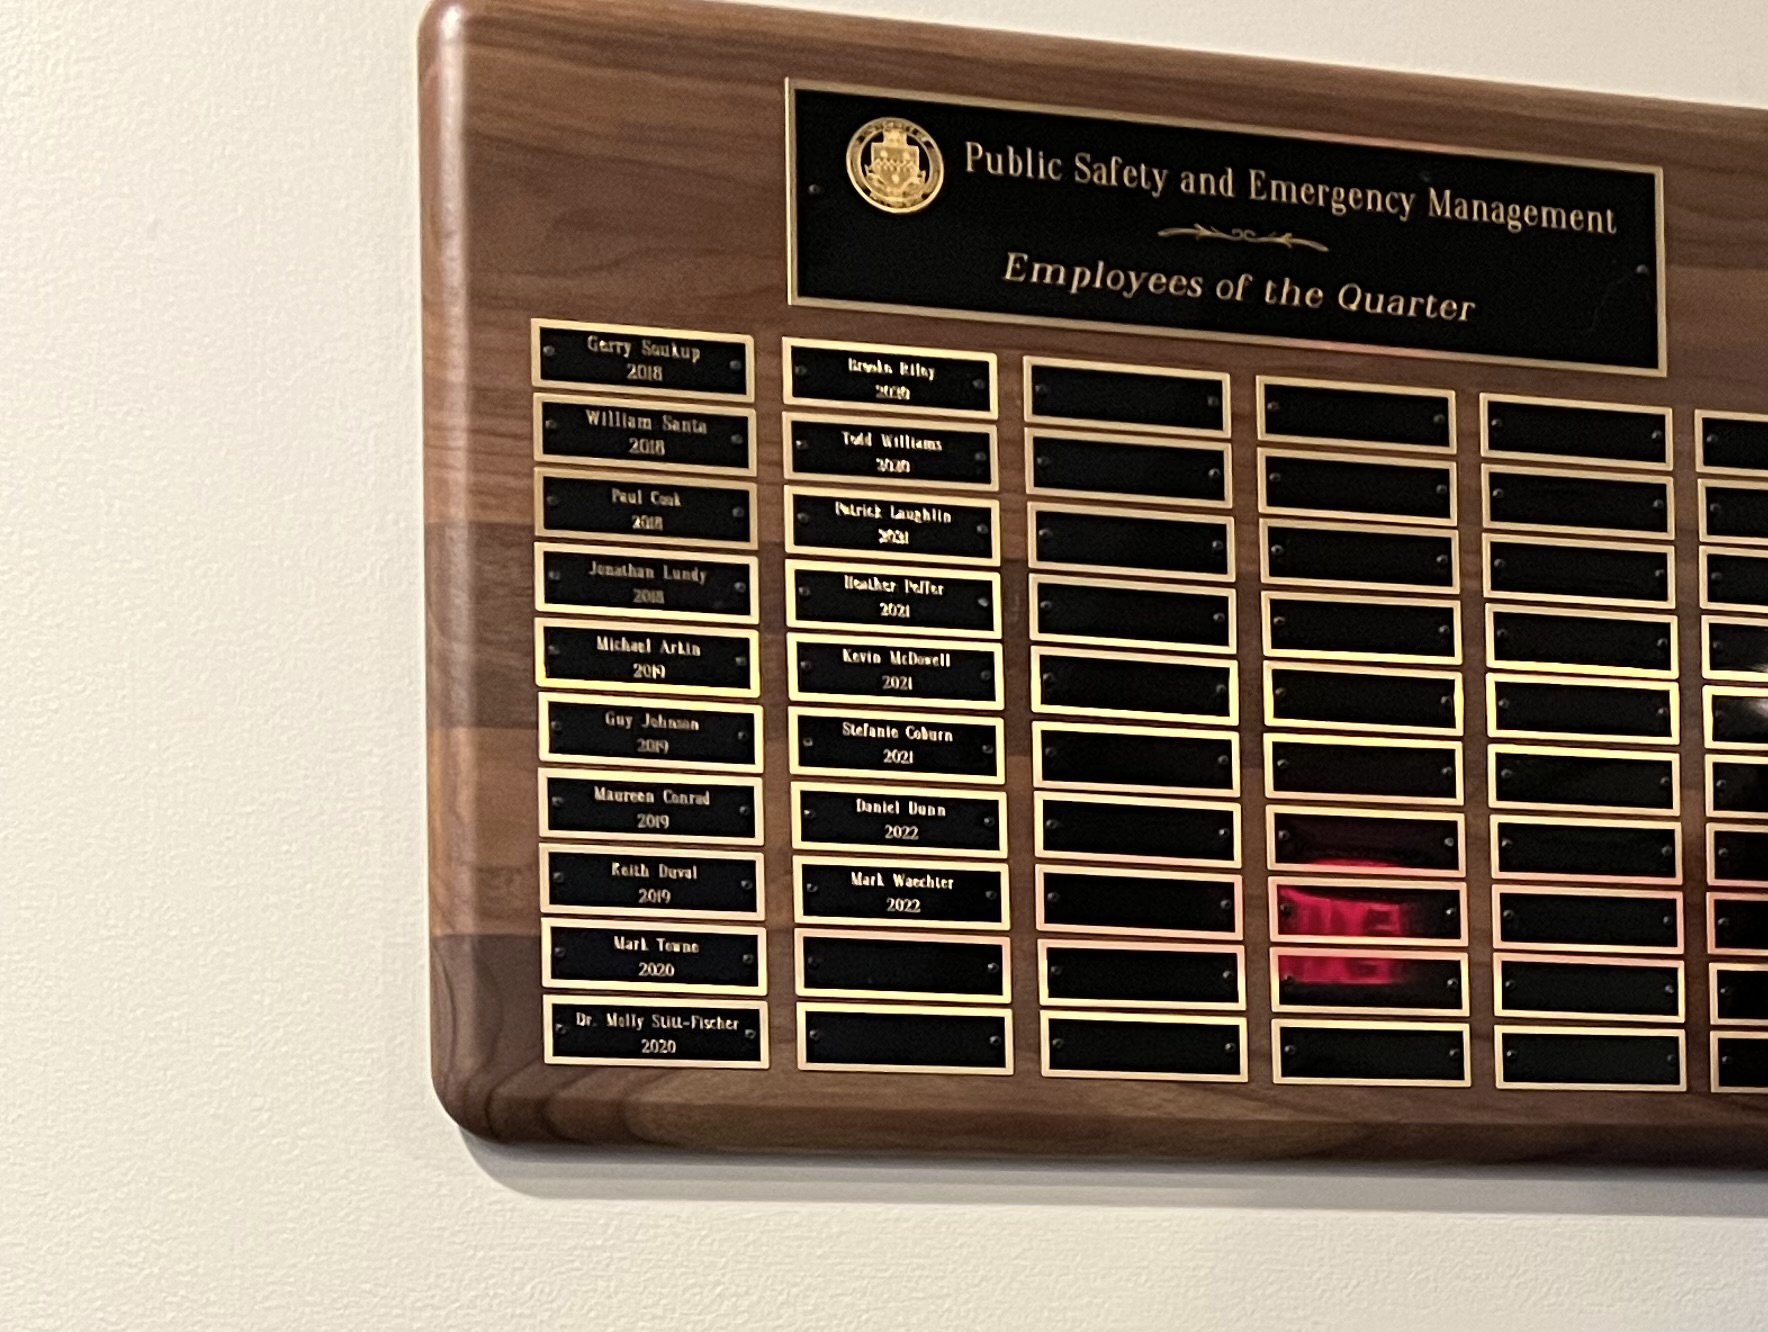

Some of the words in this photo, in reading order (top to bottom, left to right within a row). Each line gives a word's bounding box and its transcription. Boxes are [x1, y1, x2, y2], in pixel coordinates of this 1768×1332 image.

[966, 142, 1061, 180] Public
[1075, 153, 1167, 197] Safety
[1181, 168, 1234, 197] and
[1250, 170, 1414, 221] Emergency
[1429, 188, 1616, 233] Management
[1004, 253, 1202, 298] Employees
[1216, 274, 1253, 301] of
[1265, 278, 1323, 307] the
[1339, 284, 1475, 321] Quarter
[627, 364, 662, 381] 2018
[586, 408, 653, 430] William
[663, 415, 707, 434] Santa
[630, 438, 665, 455] 2018
[881, 434, 942, 450] Williams
[612, 488, 642, 504] Paul
[664, 565, 706, 585] Lundy
[880, 603, 909, 617] 2021
[597, 636, 651, 653] Michael
[843, 649, 881, 663] Kevin
[890, 651, 950, 667] McDowell
[634, 664, 665, 679] 2019
[883, 676, 912, 690] 2021
[606, 712, 632, 729] Guy
[843, 722, 898, 738] Stefanie
[906, 726, 953, 741] Coburn
[638, 739, 669, 753] 2019
[884, 749, 913, 764] 2021
[594, 786, 654, 802] Maureen
[663, 790, 710, 805] Conrad
[856, 799, 899, 814] Daniel
[909, 801, 945, 816] Dunn
[638, 814, 669, 828] 2019
[885, 825, 918, 839] 2022
[612, 862, 649, 877] Keith
[659, 864, 697, 879] Duval
[851, 872, 884, 886] Mark
[893, 874, 953, 889] Waechter
[639, 889, 671, 903] 2019
[887, 898, 920, 912] 2022
[614, 936, 648, 951] Mark
[639, 962, 674, 976] 2020
[642, 1039, 676, 1053] 2020
